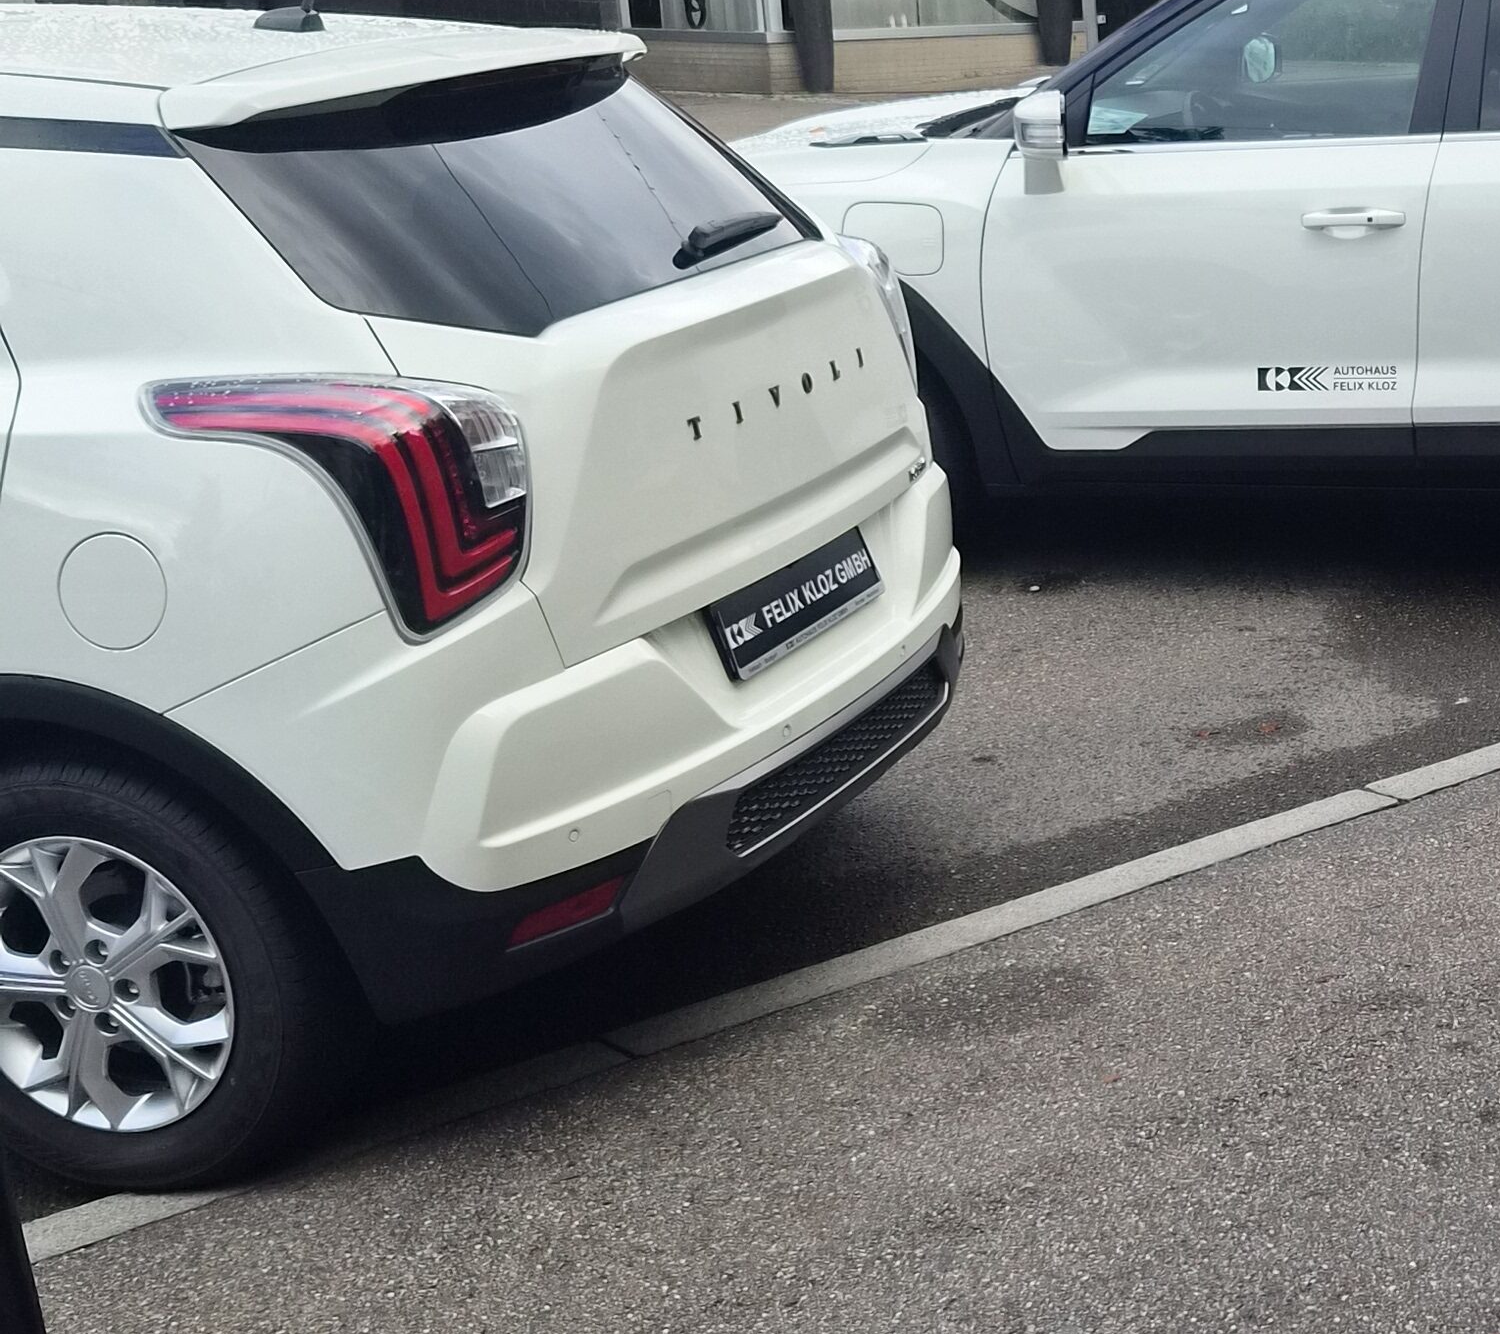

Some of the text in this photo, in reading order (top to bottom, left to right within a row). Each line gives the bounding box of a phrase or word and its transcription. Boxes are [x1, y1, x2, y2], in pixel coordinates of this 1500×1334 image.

[1333, 365, 1397, 376] AUTOHAUS
[1333, 381, 1397, 391] FELIX KLOZ
[686, 347, 864, 441] TIVOLI
[761, 588, 805, 628] FELIX
[801, 568, 839, 605] KLOZ
[834, 548, 872, 584] GMBH
